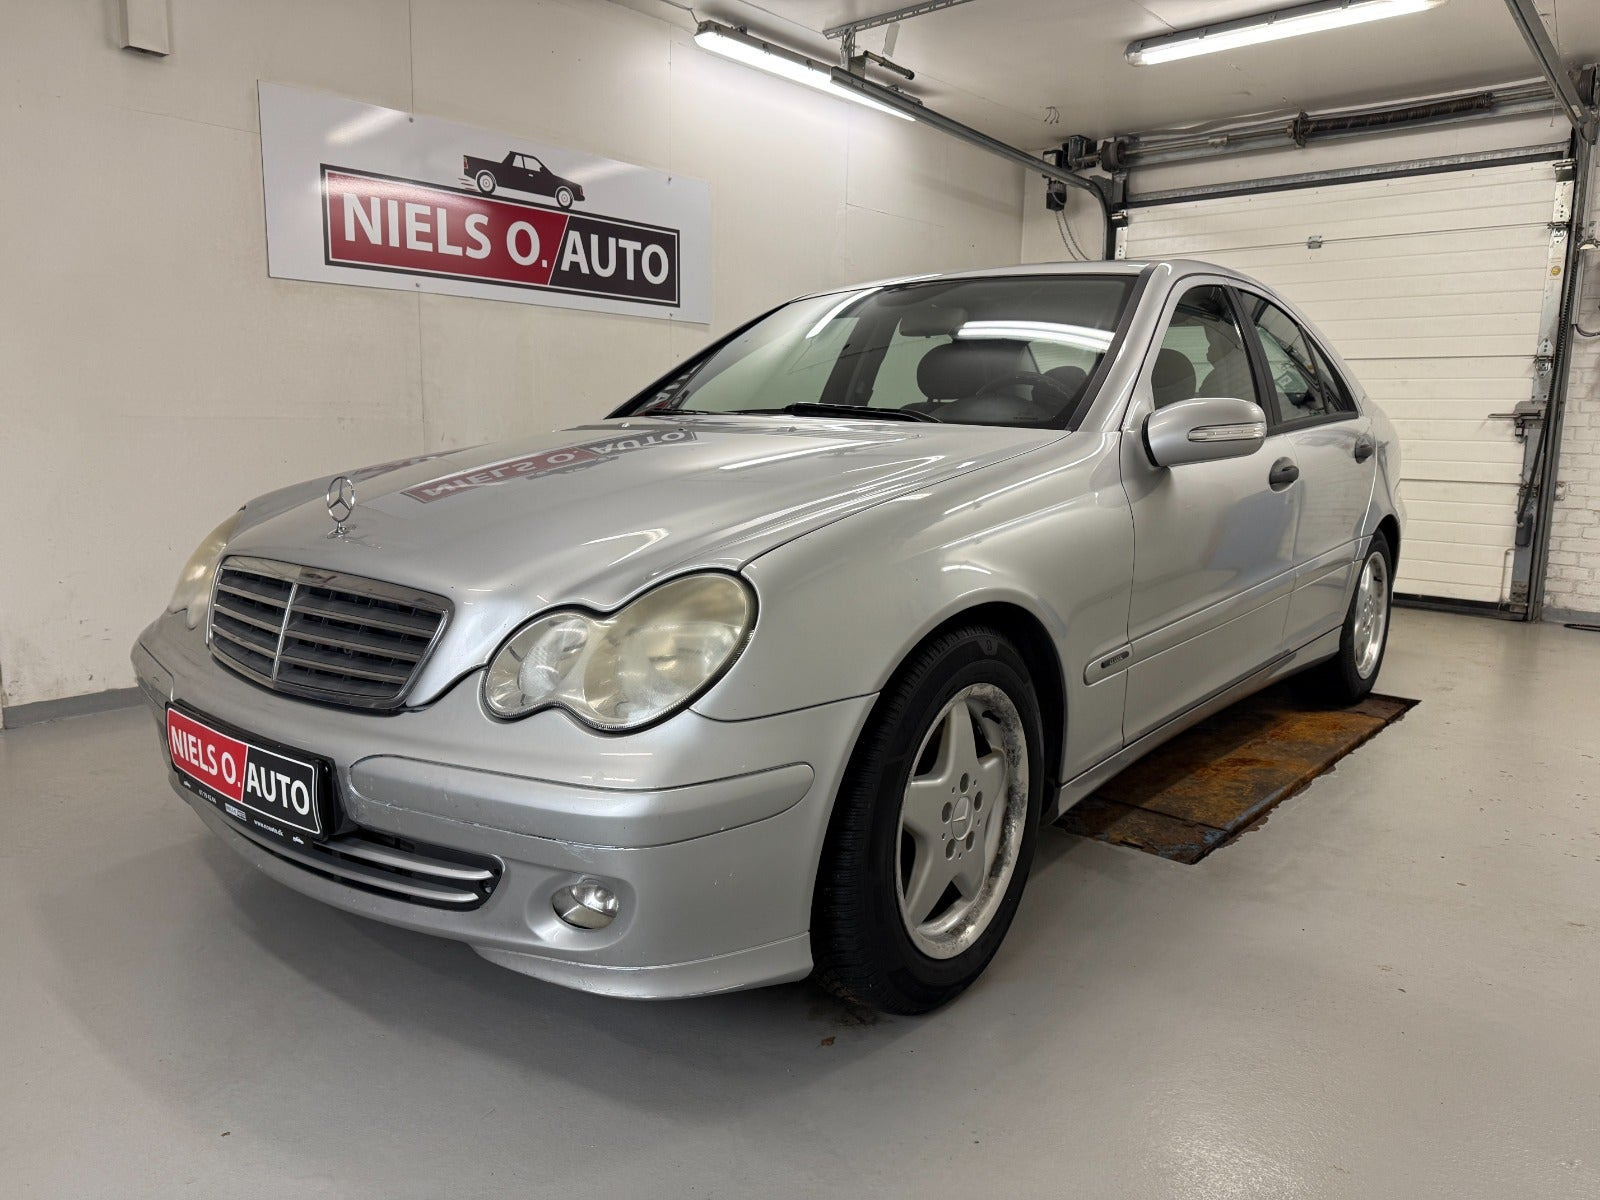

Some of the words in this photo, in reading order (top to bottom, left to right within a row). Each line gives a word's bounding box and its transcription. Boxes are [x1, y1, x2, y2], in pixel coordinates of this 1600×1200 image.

[343, 192, 491, 260] NIELS
[506, 221, 547, 268] O.
[561, 230, 669, 285] AUTO
[171, 725, 218, 776] NIELS
[221, 751, 241, 788] O.
[246, 762, 310, 816] AUTO
